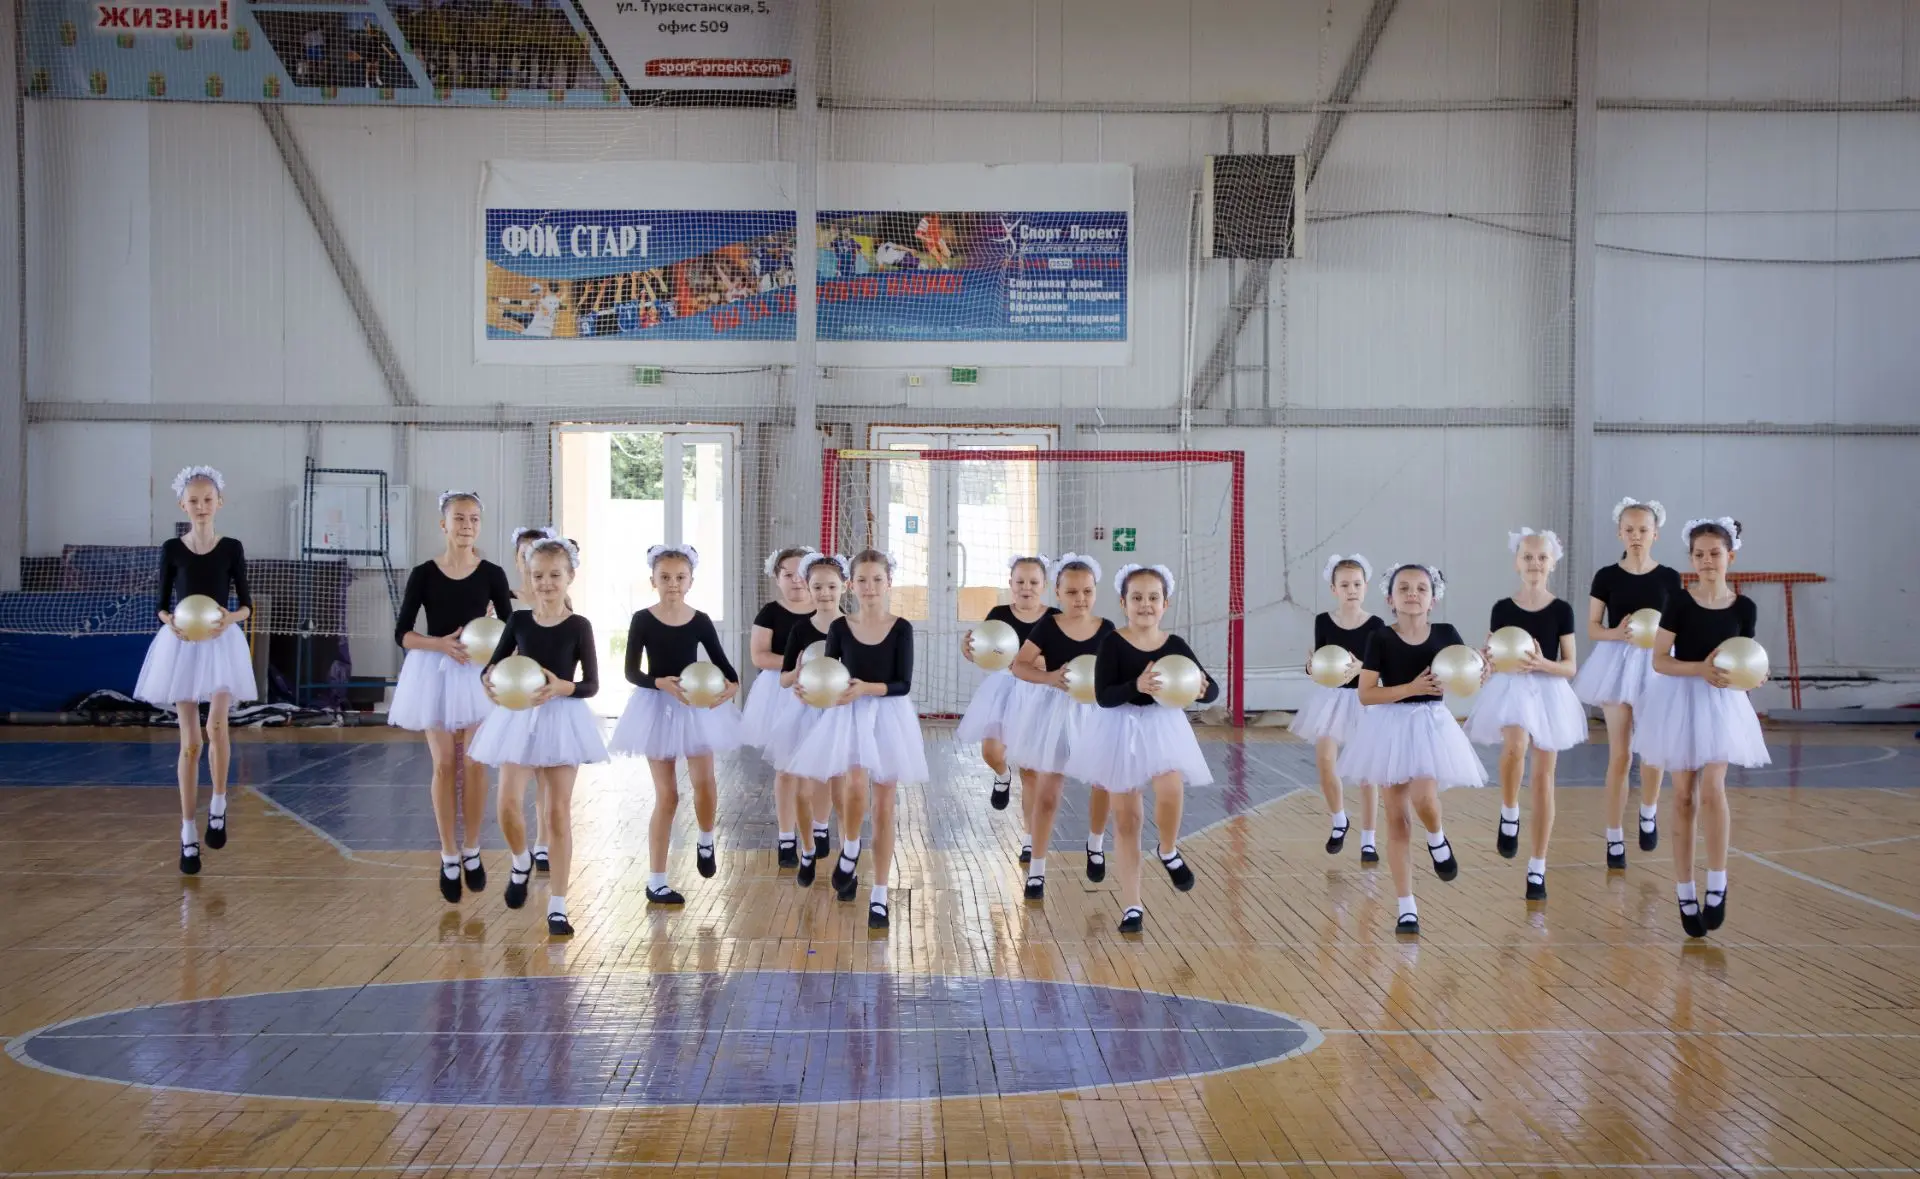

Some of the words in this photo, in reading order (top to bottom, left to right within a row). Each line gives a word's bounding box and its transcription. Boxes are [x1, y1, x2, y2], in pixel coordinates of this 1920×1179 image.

[98, 0, 229, 30] жизни!
[616, 2, 637, 14] ул.
[643, 1, 753, 15] Туркестанская,
[757, 1, 770, 14] 5,
[658, 20, 697, 34] офис
[700, 20, 729, 33] 509
[659, 60, 781, 74] sport-proekt.com
[502, 224, 560, 257] ФОК
[570, 225, 651, 257] СТАРТ
[1020, 224, 1062, 242] Спорт
[1070, 224, 1120, 242] Проект
